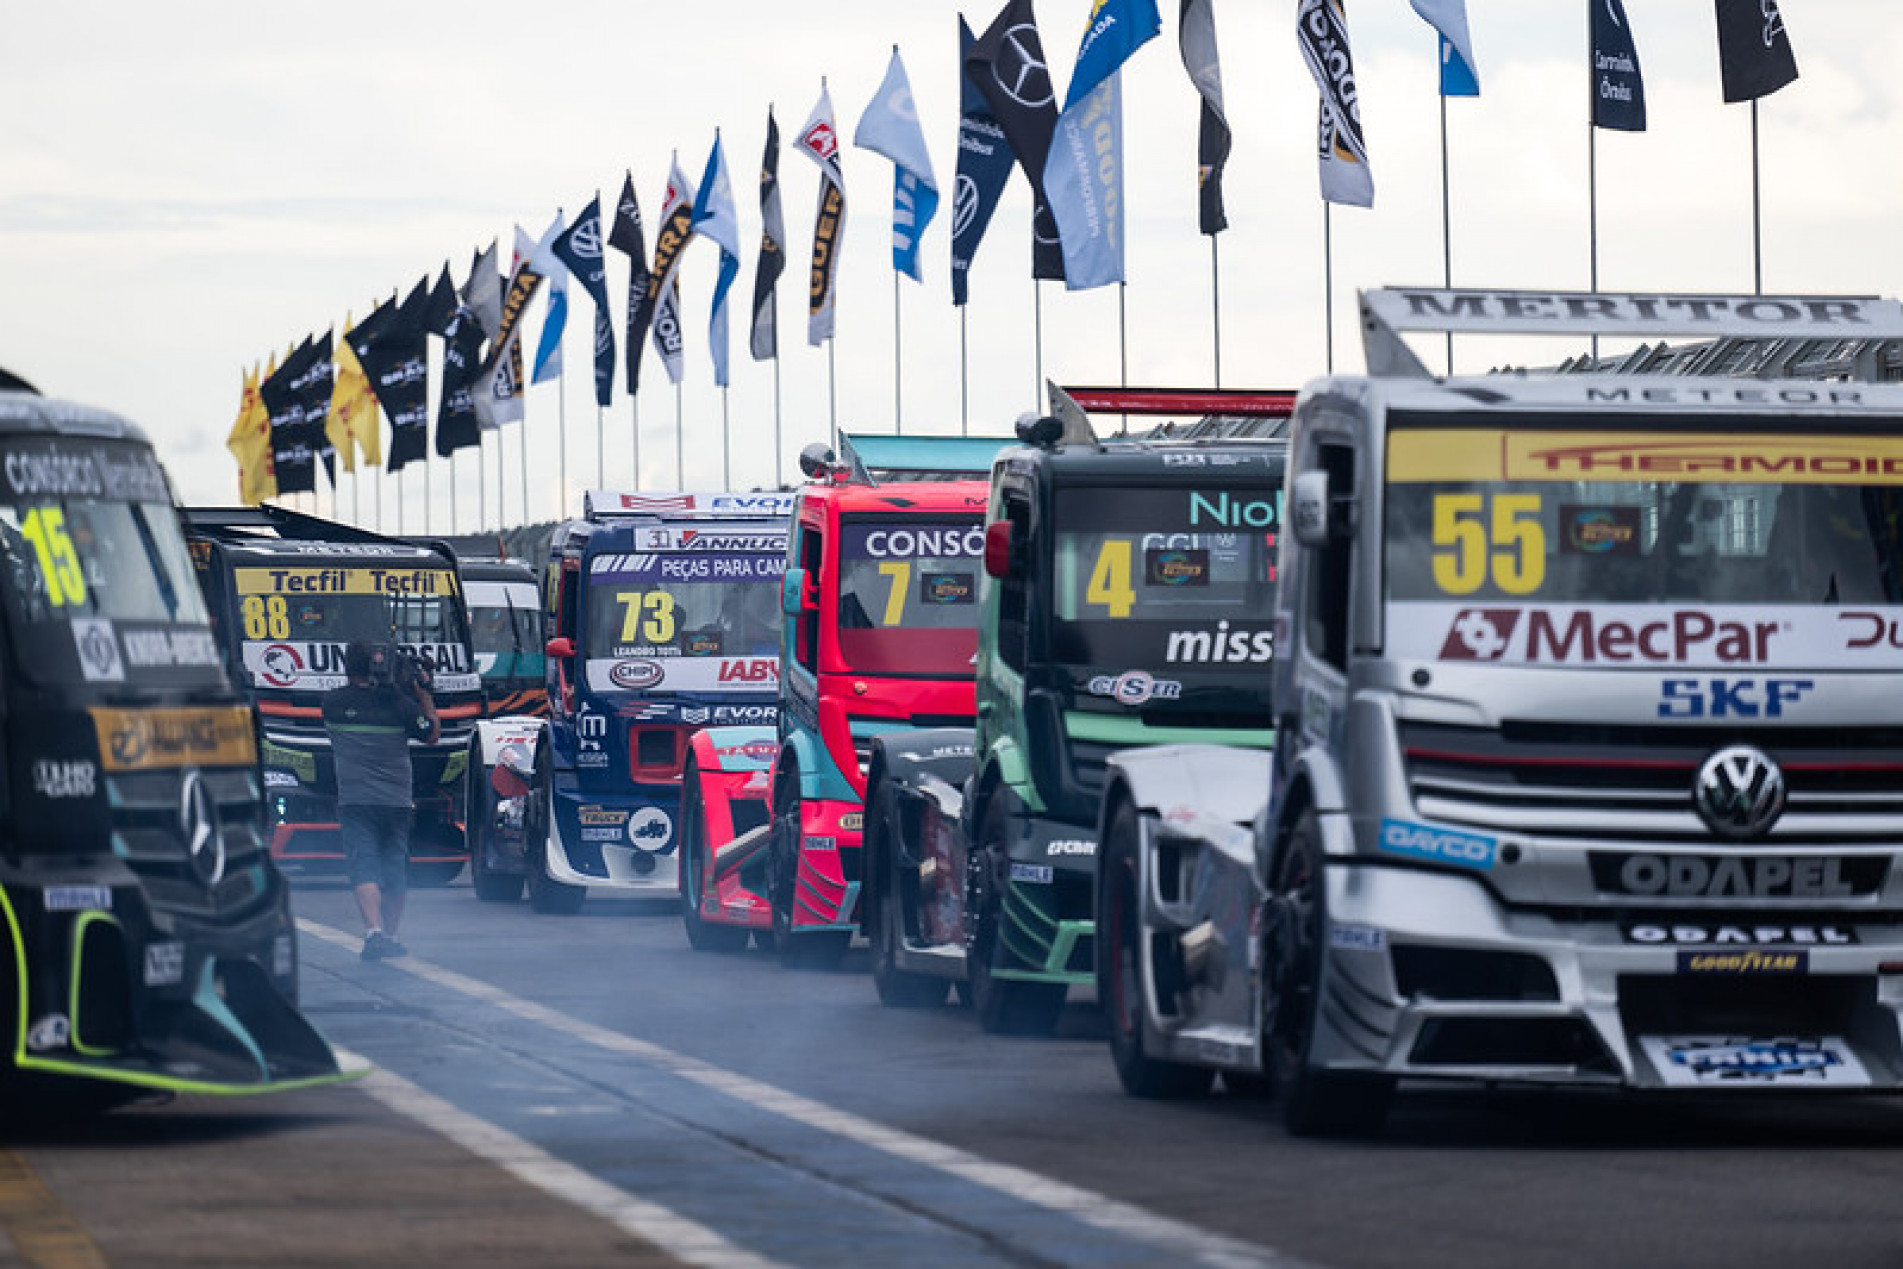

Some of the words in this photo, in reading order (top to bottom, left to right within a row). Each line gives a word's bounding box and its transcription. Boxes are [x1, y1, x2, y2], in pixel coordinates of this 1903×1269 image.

[1405, 294, 1870, 325] MERITOR
[1586, 386, 1863, 405] METEOR
[21, 506, 87, 606] 15
[866, 526, 985, 557] CONSÓ
[1431, 493, 1547, 595] 55
[270, 571, 347, 592] Tecfil
[369, 571, 436, 593] Tecfil
[661, 559, 709, 581] PEÇAS
[714, 559, 751, 576] PARA
[1086, 540, 1136, 618] 4
[878, 561, 910, 626] 7
[243, 596, 291, 640] 88
[615, 590, 675, 644] 73
[1525, 611, 1778, 662] MecPar
[1166, 619, 1273, 662] miss
[1658, 679, 1815, 718] SKF
[1385, 825, 1490, 862] DAYCO
[1620, 855, 1853, 896] ODAPEL
[1630, 924, 1851, 944] ODAPEL
